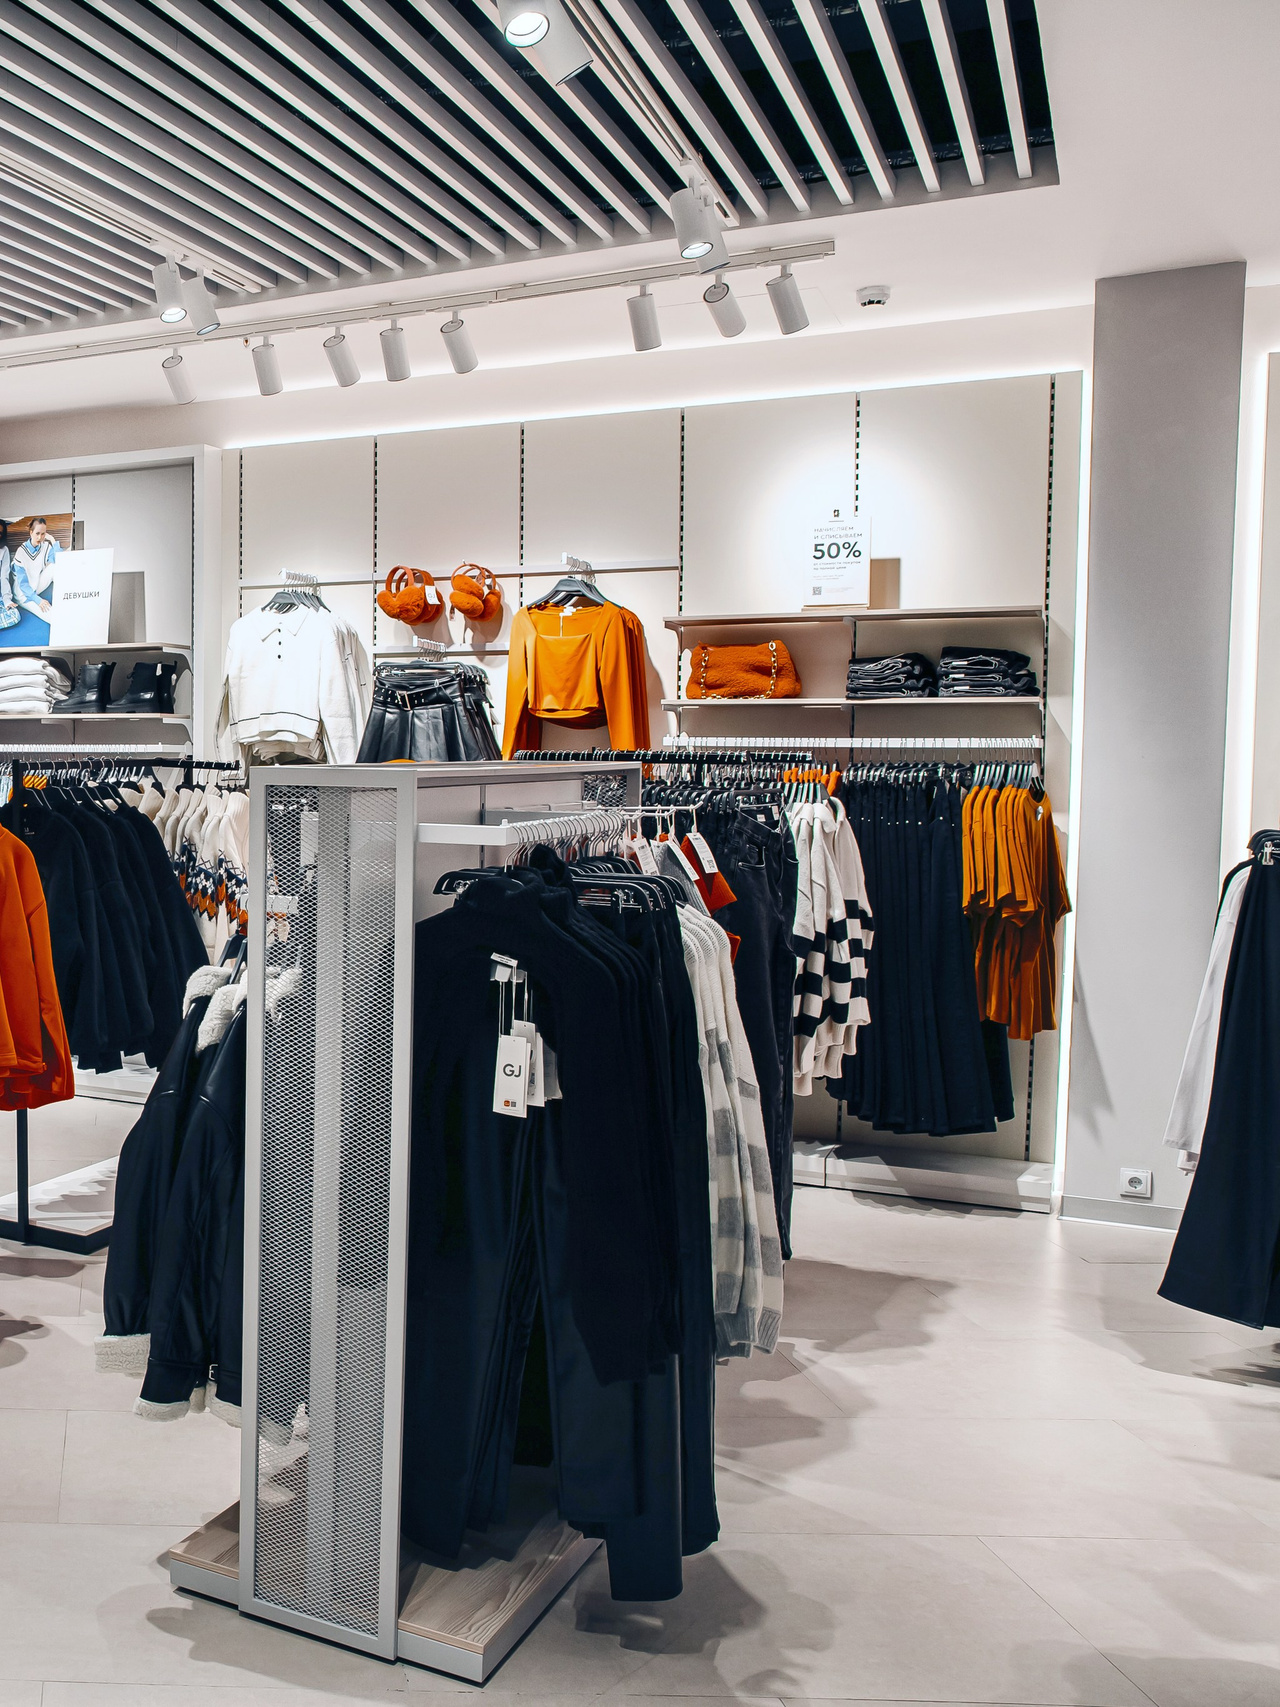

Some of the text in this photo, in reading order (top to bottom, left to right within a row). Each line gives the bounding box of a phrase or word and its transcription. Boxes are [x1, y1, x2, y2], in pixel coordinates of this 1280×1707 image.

[812, 541, 862, 560] 50%
[63, 591, 100, 600] ДЕВУШКИ
[503, 1063, 521, 1078] GJ
